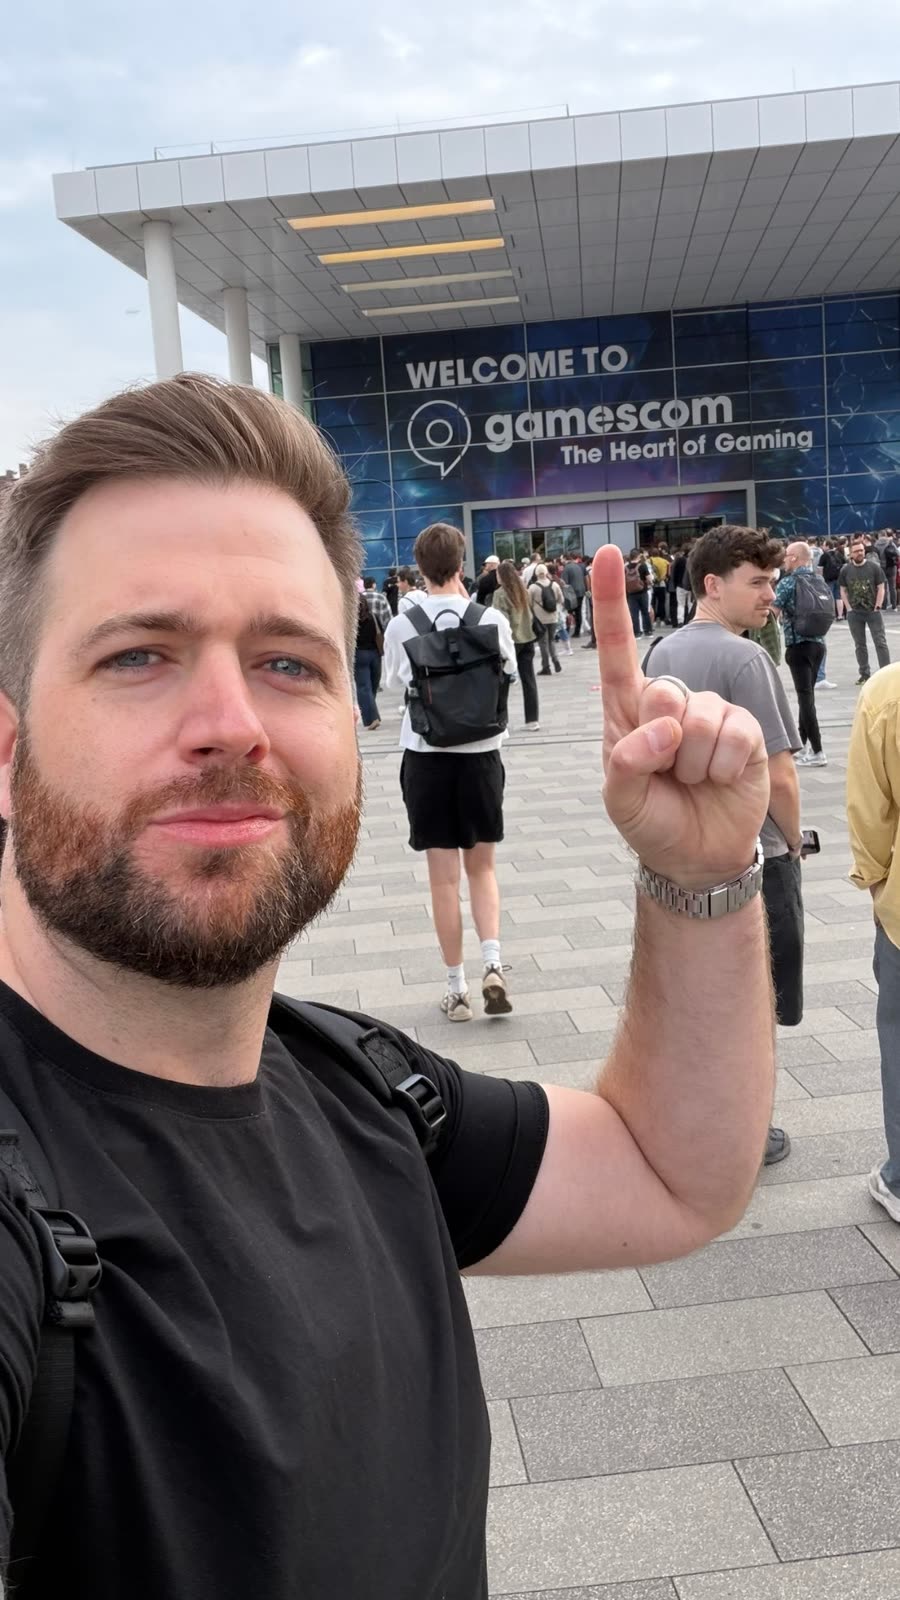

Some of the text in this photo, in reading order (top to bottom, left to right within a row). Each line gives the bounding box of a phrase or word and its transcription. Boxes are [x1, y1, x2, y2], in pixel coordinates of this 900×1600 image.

[406, 345, 629, 389] WELCOME TO
[485, 395, 733, 452] gamescom
[560, 429, 813, 465] The Heart of Gaming
